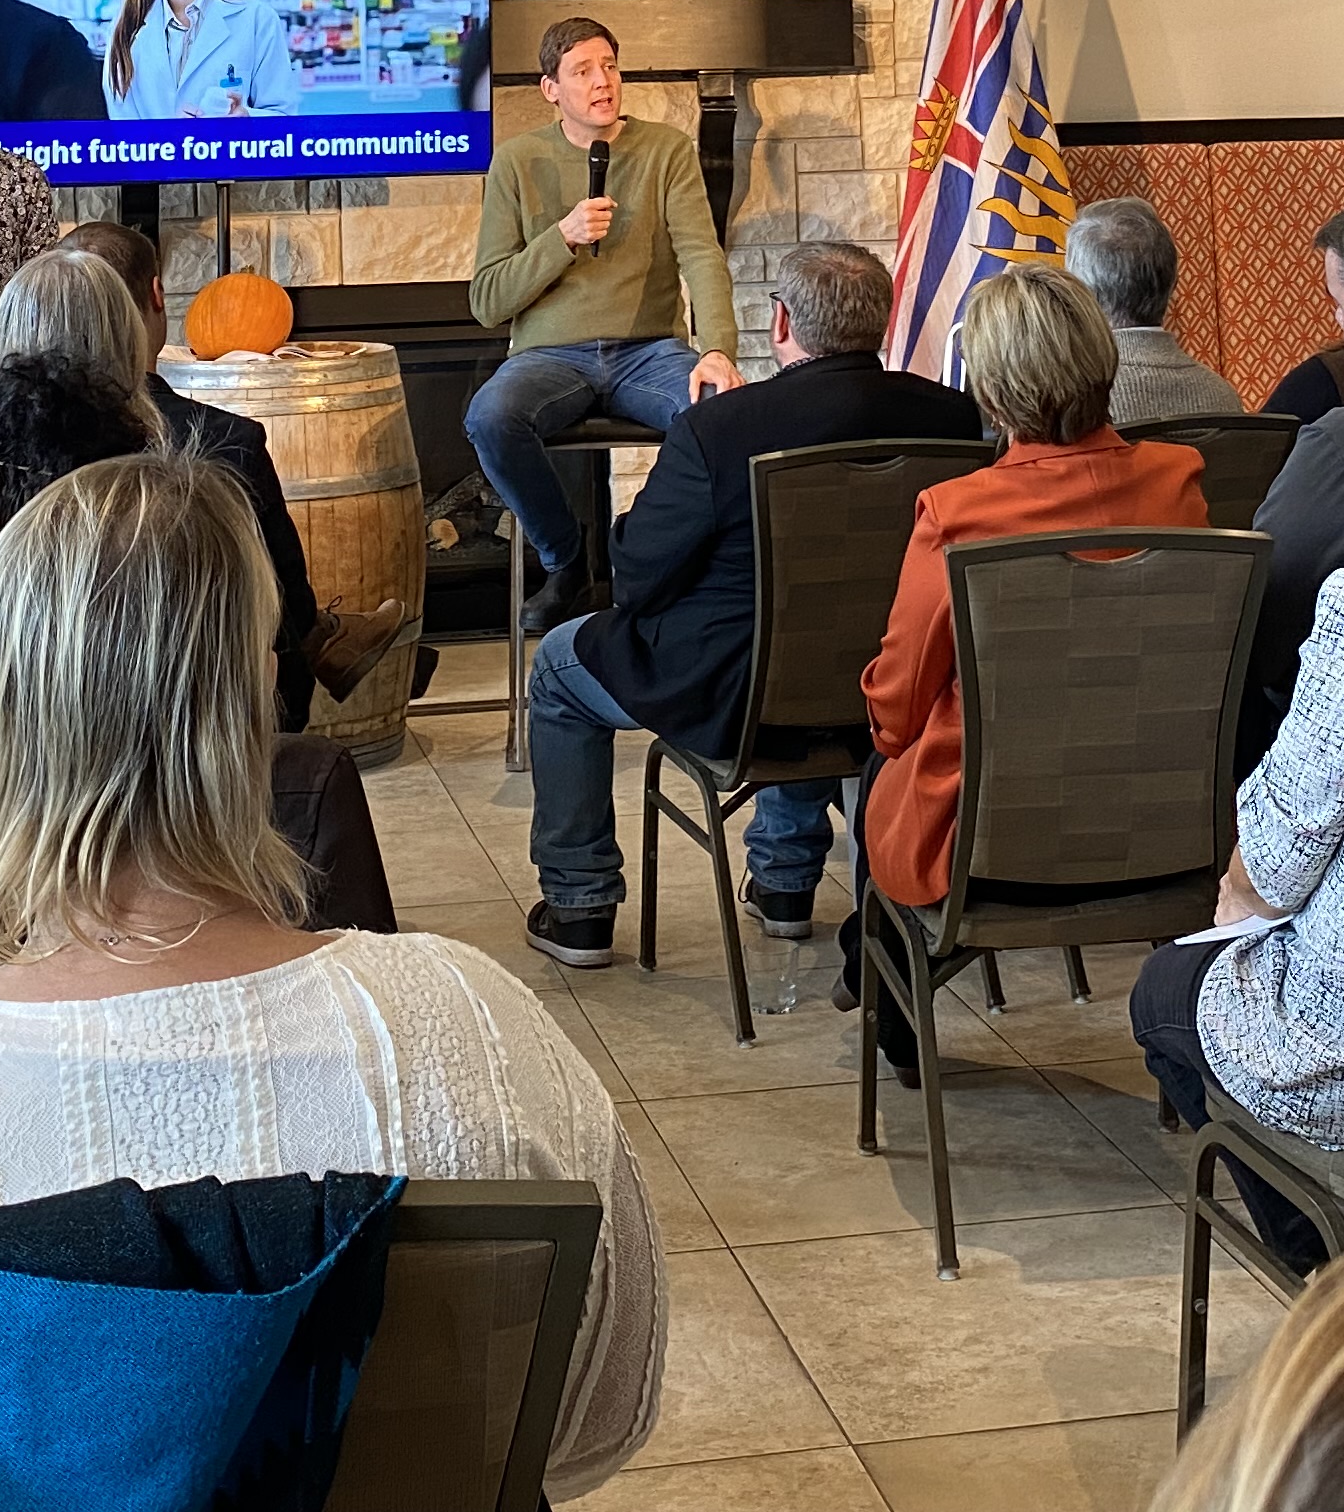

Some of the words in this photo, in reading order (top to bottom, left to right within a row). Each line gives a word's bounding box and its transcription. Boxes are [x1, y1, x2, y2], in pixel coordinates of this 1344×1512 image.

[88, 138, 175, 164] future
[182, 136, 222, 161] for
[229, 134, 293, 159] rural
[301, 130, 470, 157] communities
